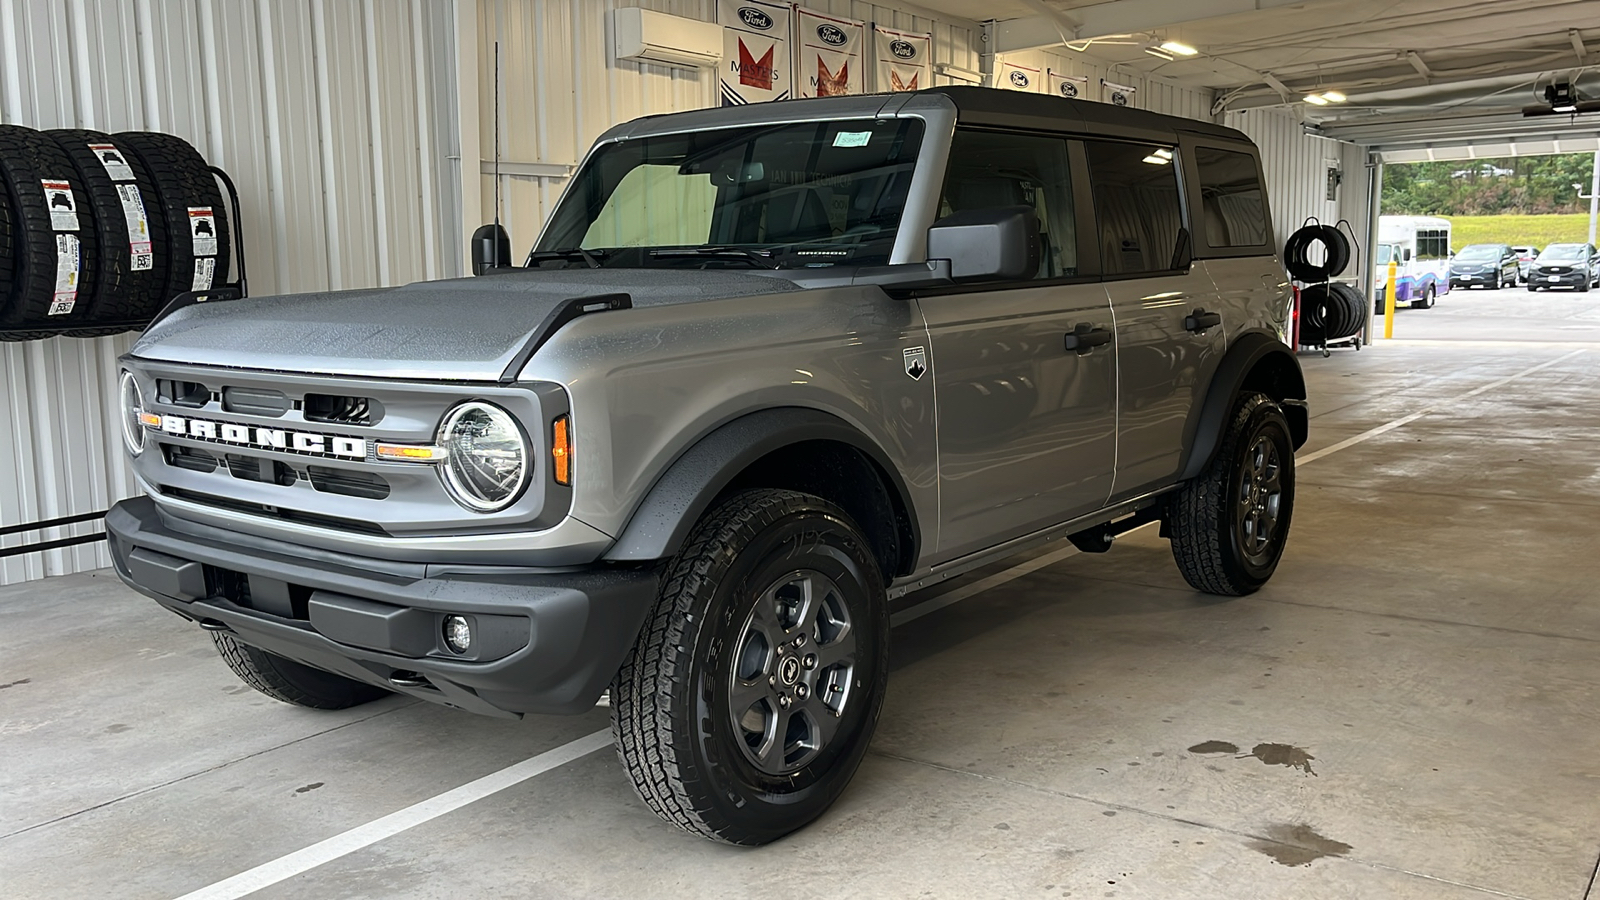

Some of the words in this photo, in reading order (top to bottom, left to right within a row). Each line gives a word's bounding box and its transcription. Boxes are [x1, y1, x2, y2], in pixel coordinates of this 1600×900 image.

[743, 8, 768, 27] Ford
[821, 26, 842, 44] Ford
[893, 42, 912, 57] Ford
[731, 61, 779, 81] MASTERS
[162, 415, 367, 458] BRONCO
